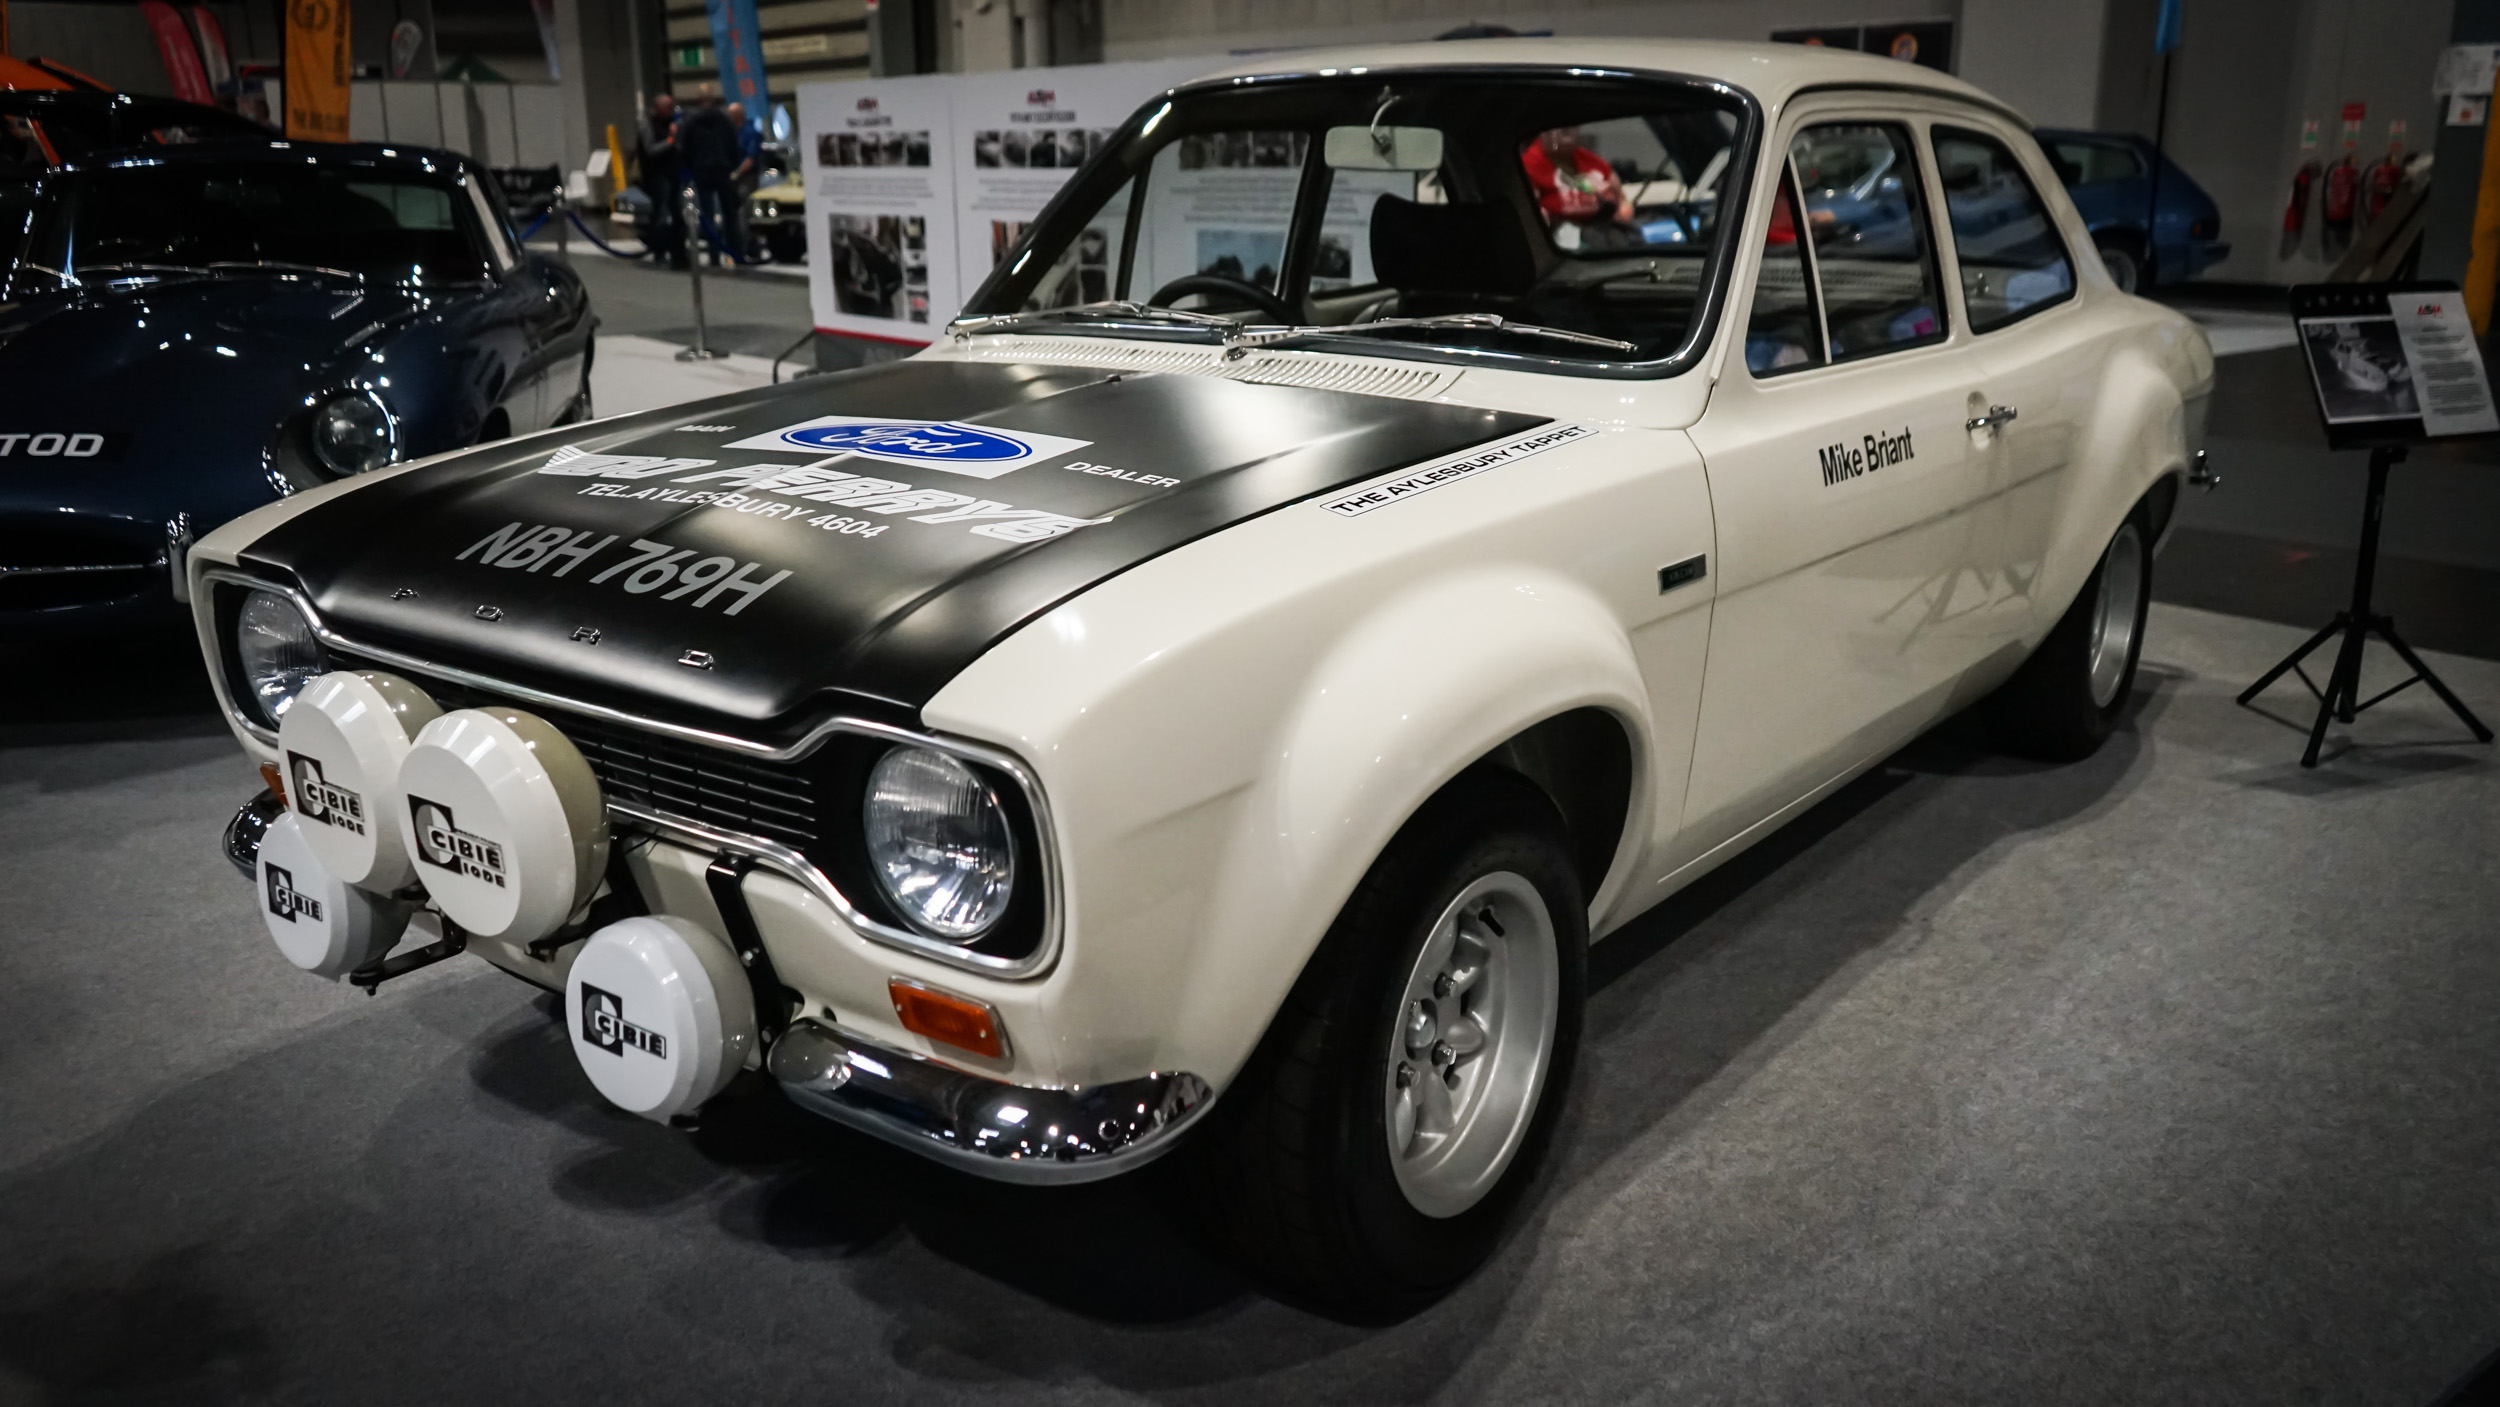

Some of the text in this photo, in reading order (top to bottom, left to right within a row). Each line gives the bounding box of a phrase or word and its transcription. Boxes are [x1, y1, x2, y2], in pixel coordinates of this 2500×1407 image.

[820, 427, 983, 455] Ford
[1330, 425, 1587, 513] THE AYLESBURY TAPPET
[1819, 426, 1915, 487] Mike Briant
[1064, 461, 1181, 488] DEALER
[669, 463, 1114, 544] PERRYS
[806, 512, 890, 539] 4604
[455, 522, 795, 617] NBH 769H
[331, 813, 366, 837] IODE
[463, 862, 506, 889] IODE
